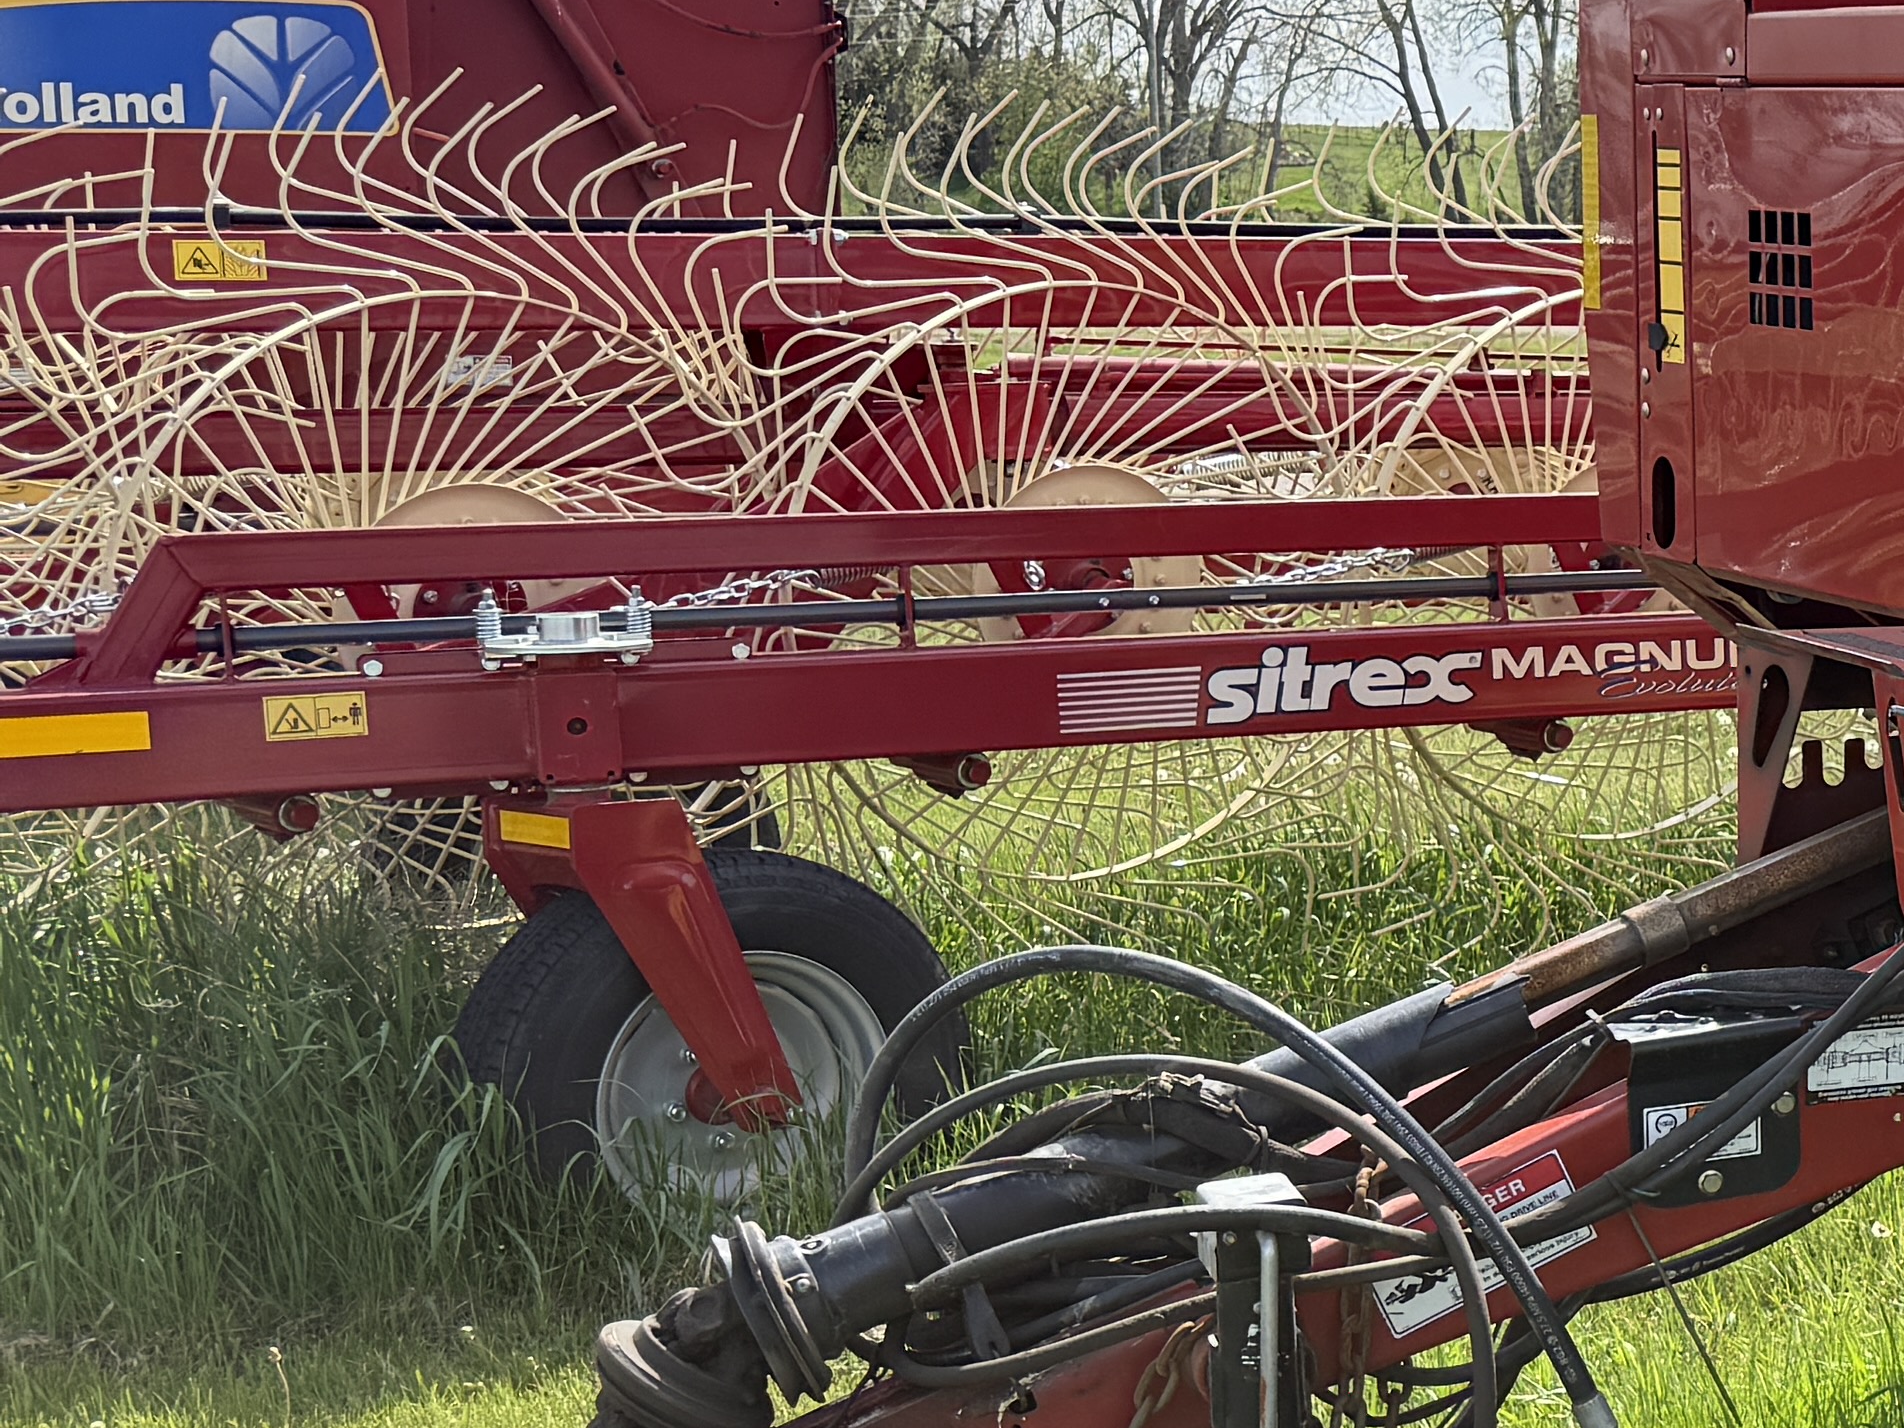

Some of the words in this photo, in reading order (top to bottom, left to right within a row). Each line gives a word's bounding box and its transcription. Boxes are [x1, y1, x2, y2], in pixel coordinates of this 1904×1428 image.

[0, 81, 186, 124] olland
[1206, 645, 1483, 724] sitrex
[1490, 637, 1738, 680] MAGNU
[1482, 1178, 1527, 1208] GER
